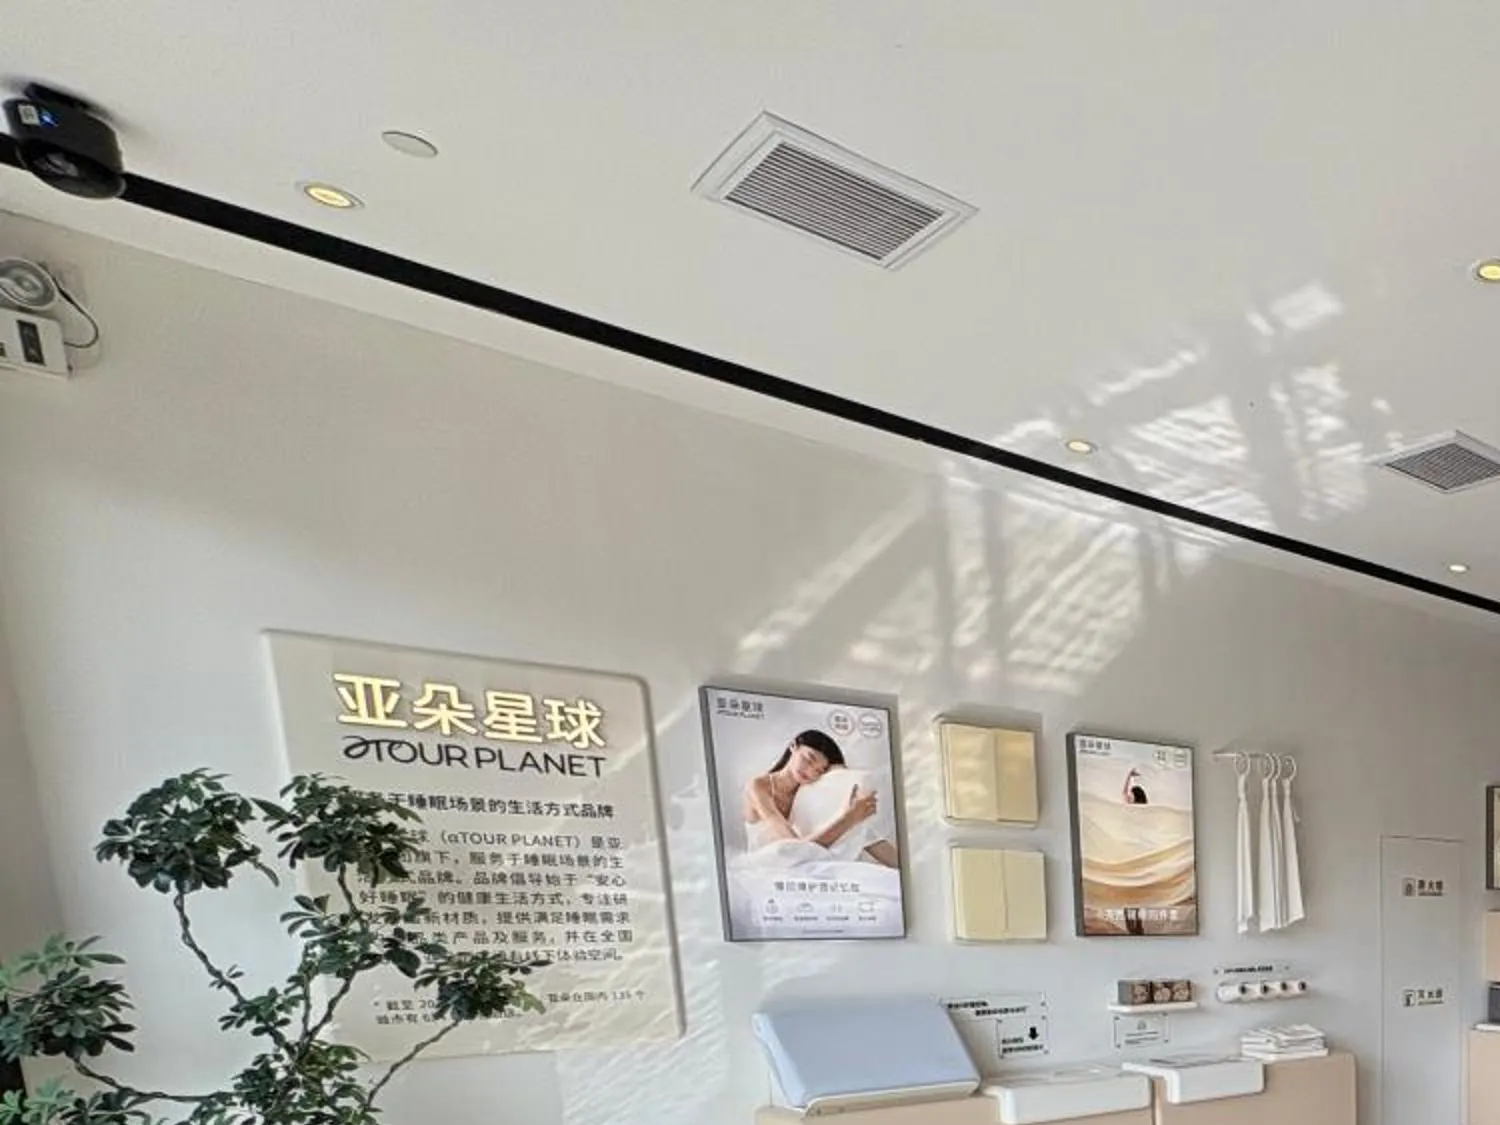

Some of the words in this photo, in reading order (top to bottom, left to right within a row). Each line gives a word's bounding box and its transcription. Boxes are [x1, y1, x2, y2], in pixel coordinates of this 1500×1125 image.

[333, 672, 607, 750] 亚朵星球
[475, 747, 607, 779] PLANET
[364, 789, 615, 819] 于睡眠场景的生活方式品牌
